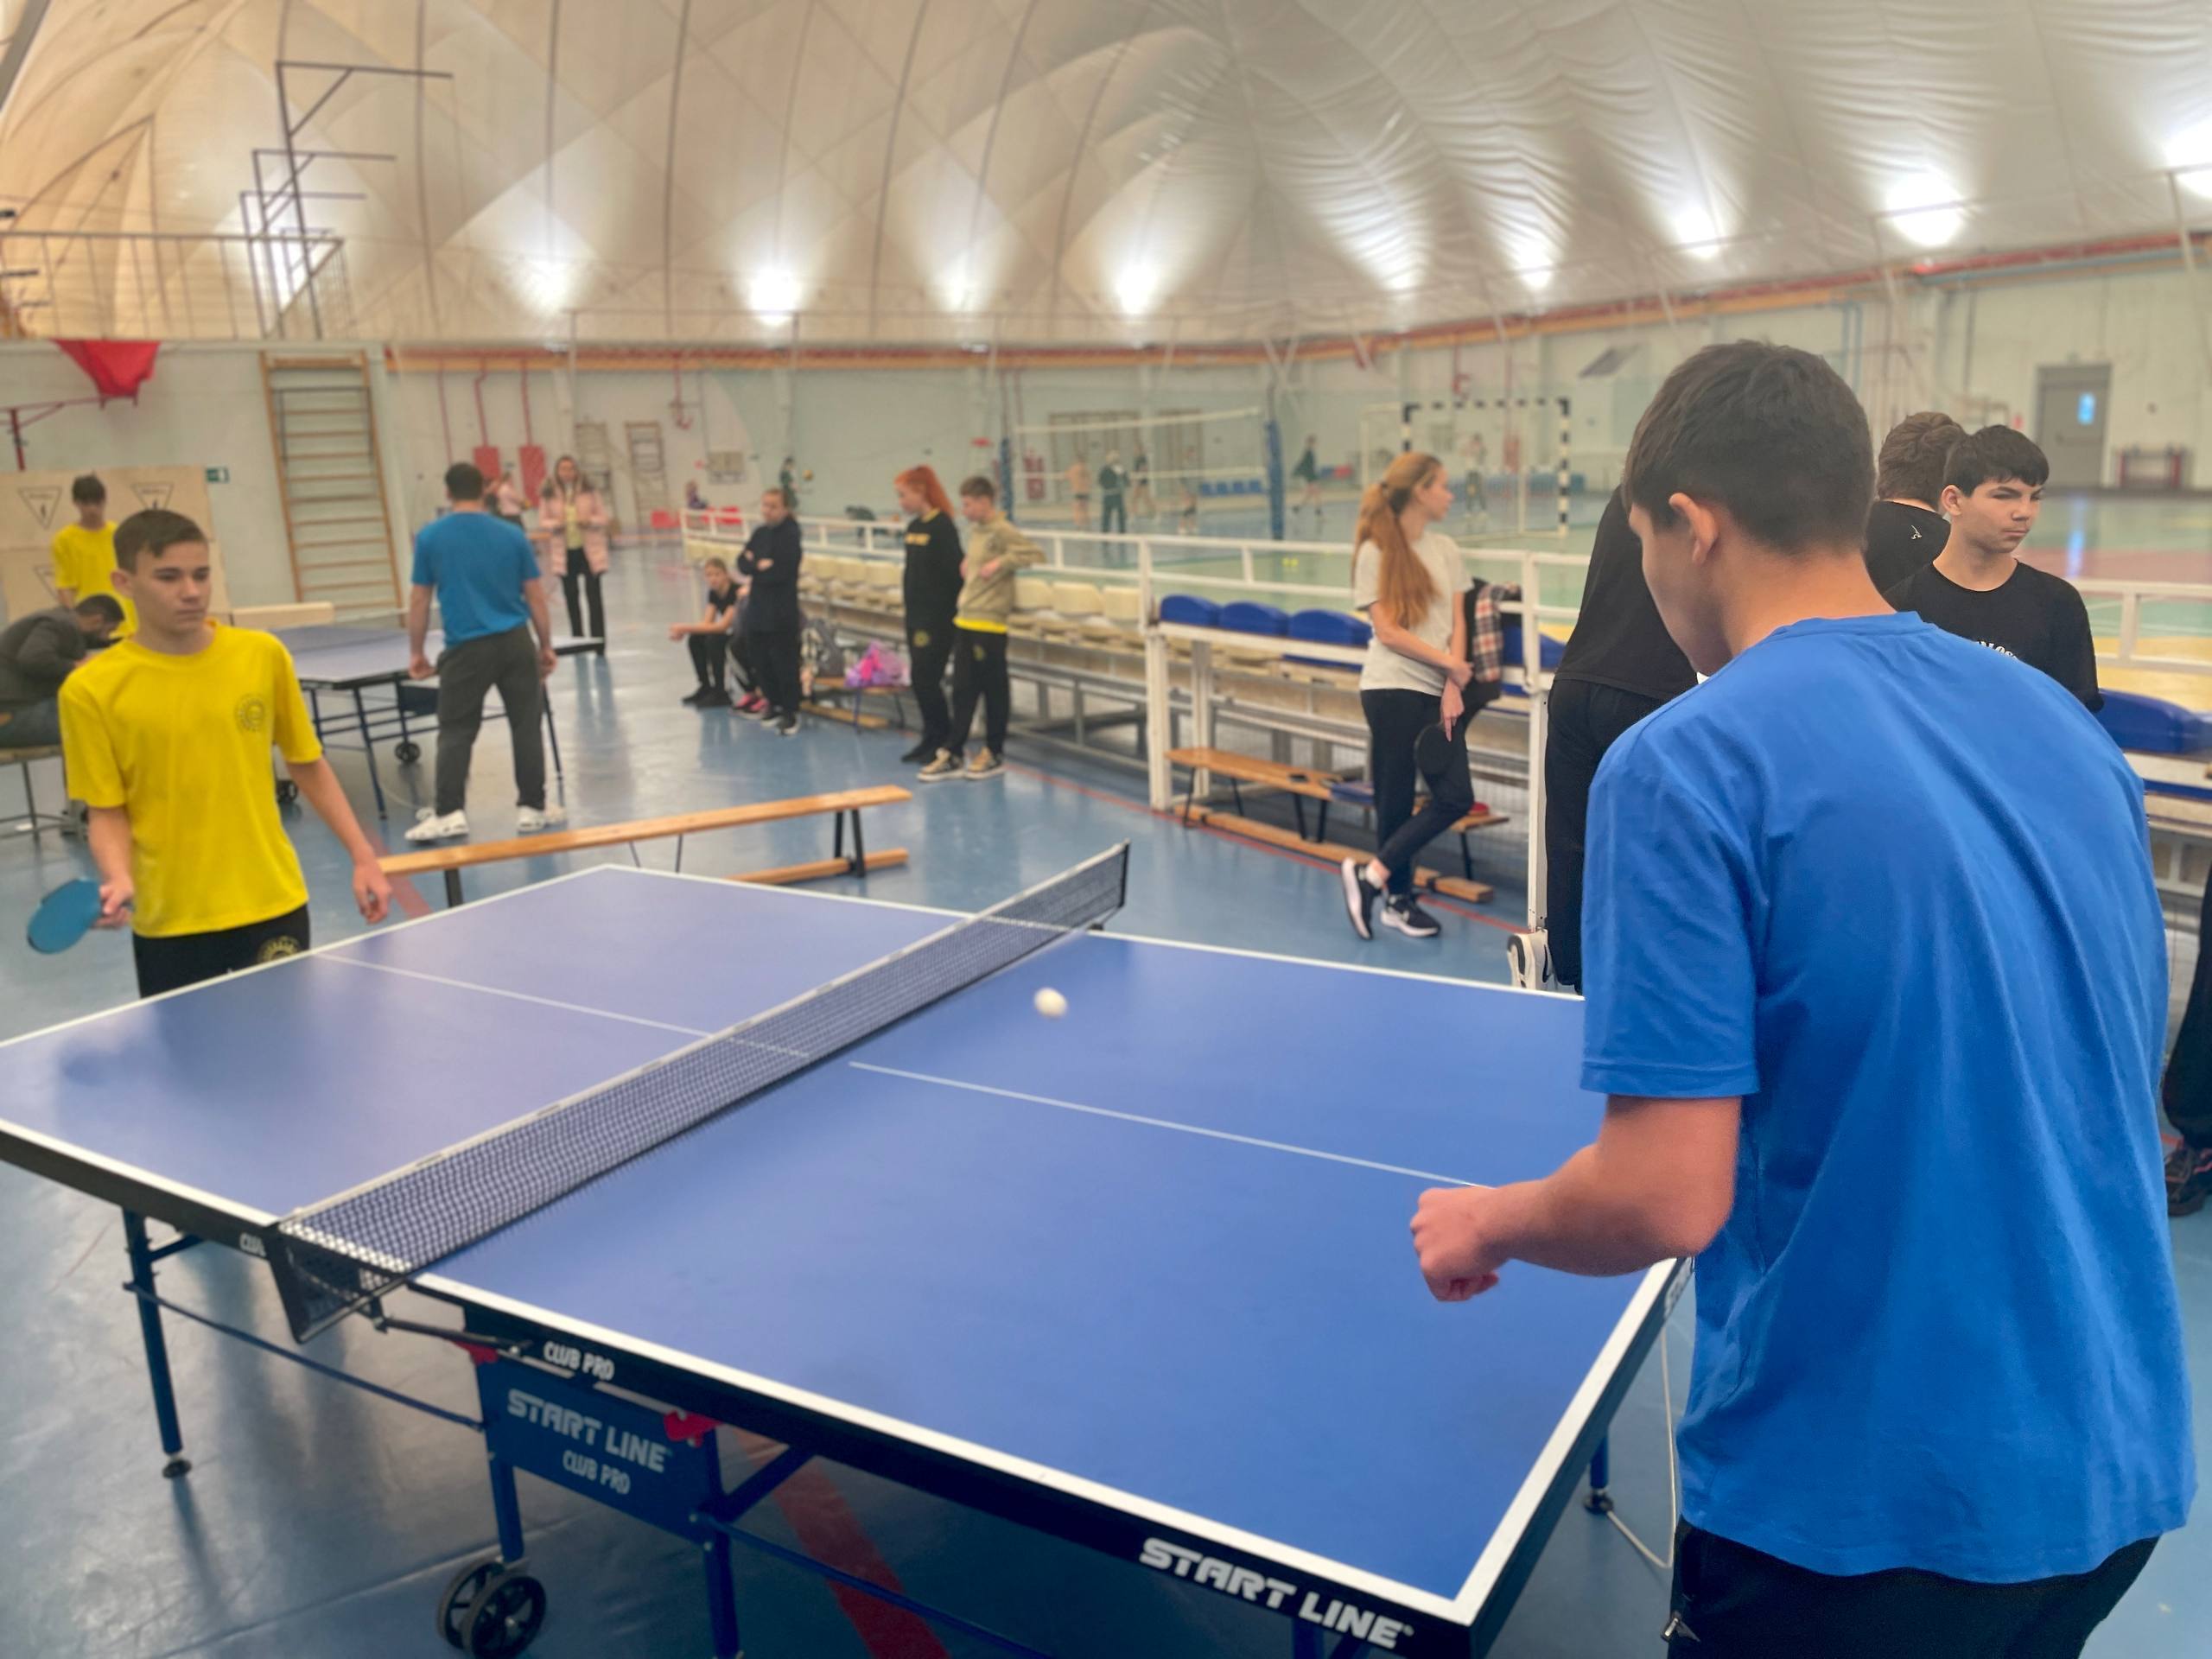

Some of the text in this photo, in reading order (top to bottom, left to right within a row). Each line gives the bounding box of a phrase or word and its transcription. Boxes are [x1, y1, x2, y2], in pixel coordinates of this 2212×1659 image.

[543, 1341, 615, 1381] CLUB PRO
[507, 1389, 668, 1473] START LINE
[563, 1450, 632, 1495] CLUB PRO
[1139, 1537, 1405, 1649] START LINE
